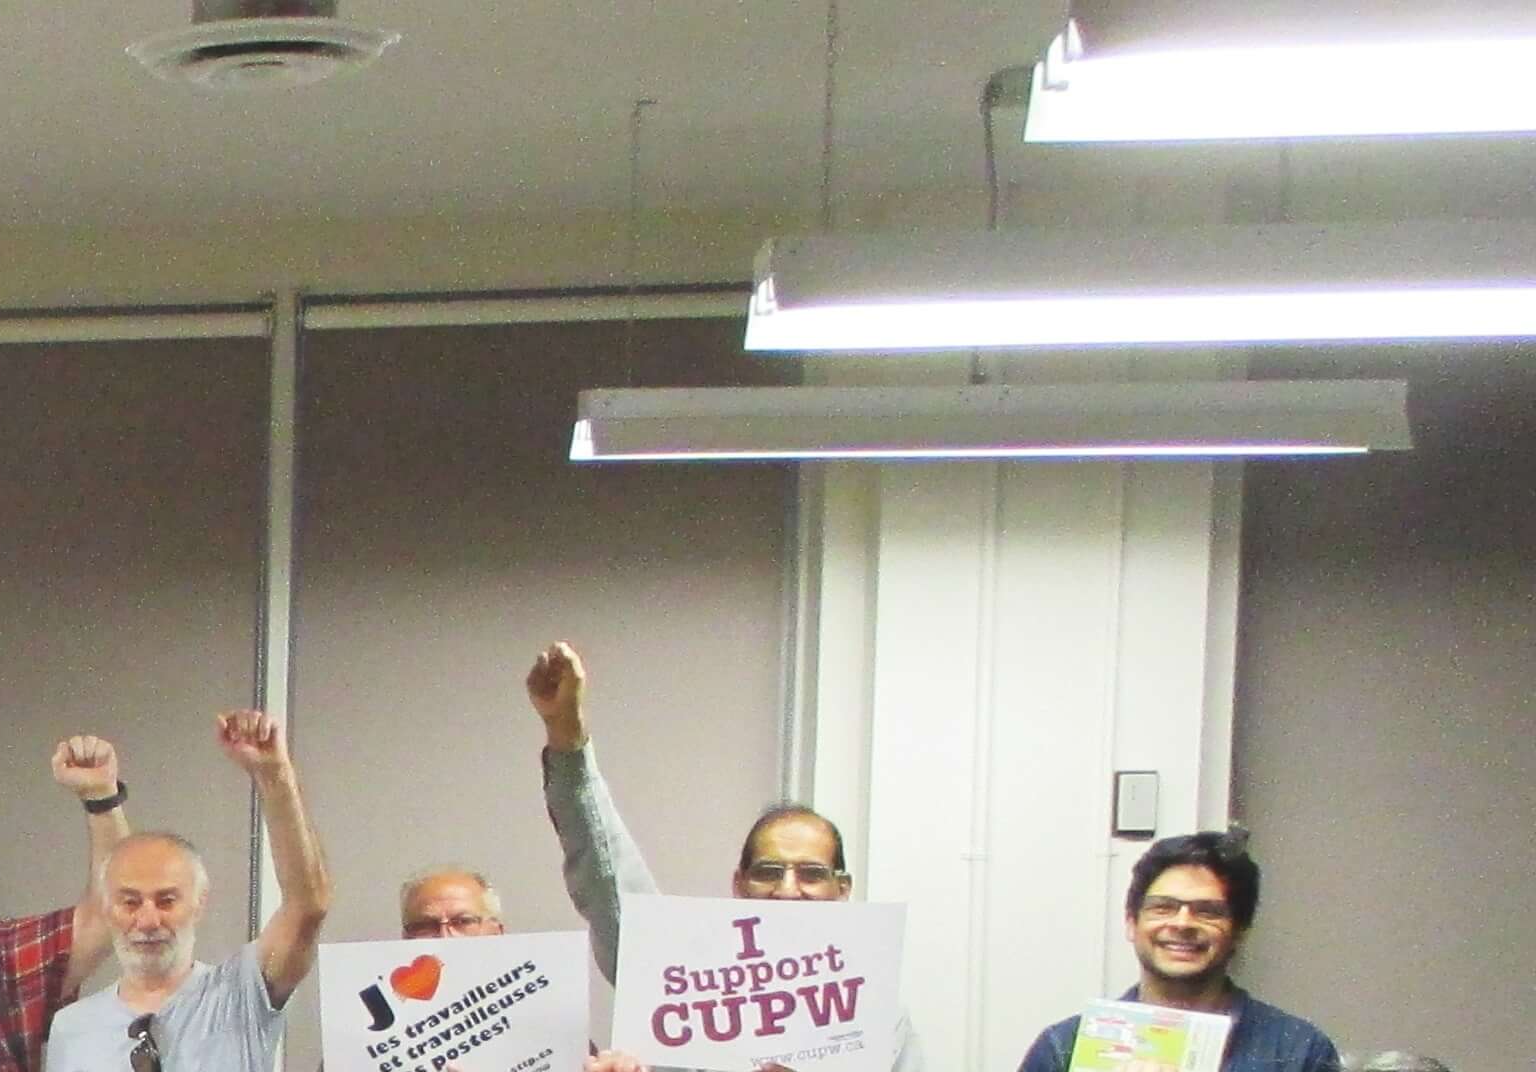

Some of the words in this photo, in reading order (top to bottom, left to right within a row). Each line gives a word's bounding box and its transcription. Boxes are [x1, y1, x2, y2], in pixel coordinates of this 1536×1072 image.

[732, 916, 765, 960] I
[664, 944, 845, 995] Support
[358, 975, 383, 1032] J'
[365, 1034, 401, 1059] les
[405, 959, 536, 1038] travailleurs
[407, 974, 549, 1059] travailleuses
[651, 977, 865, 1048] CUPW
[431, 1015, 511, 1071] postes!
